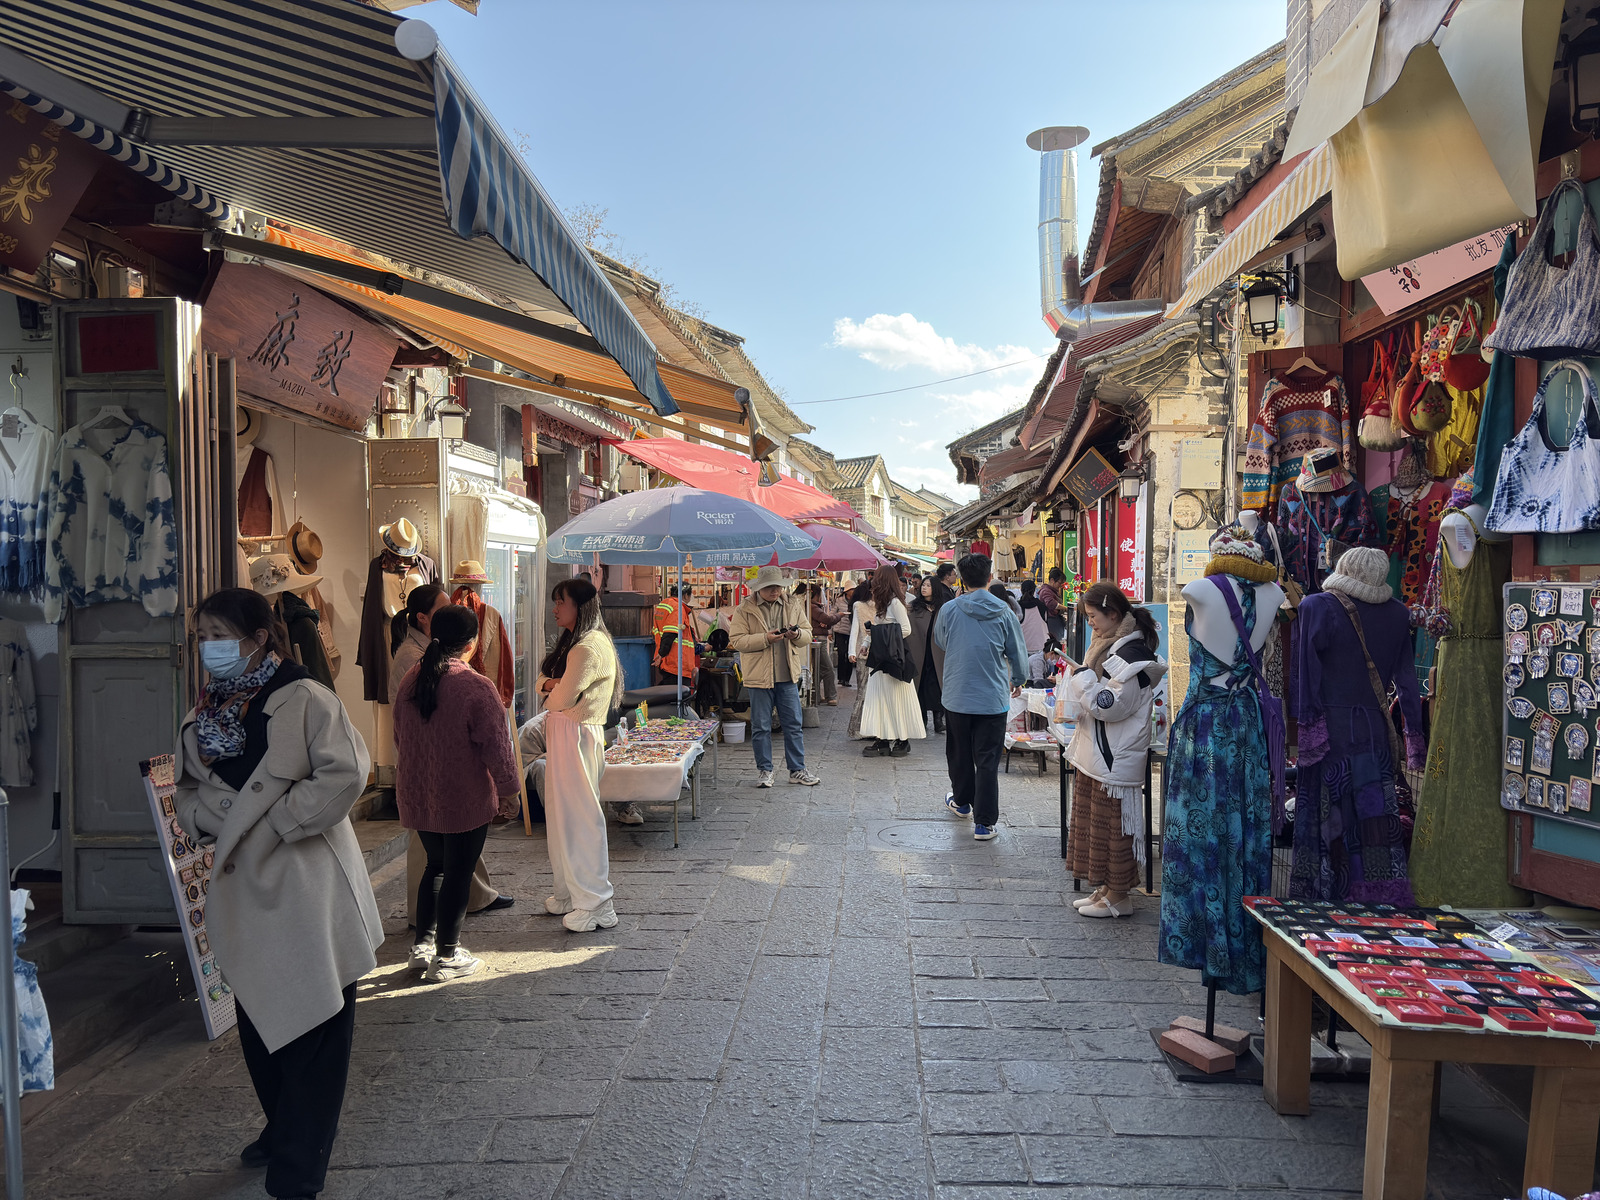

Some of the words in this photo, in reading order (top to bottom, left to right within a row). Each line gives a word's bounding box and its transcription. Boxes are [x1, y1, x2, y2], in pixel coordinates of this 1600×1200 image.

[1464, 238, 1493, 261] 批发
[279, 378, 307, 396] MAZHI
[615, 535, 647, 544] 用雨洁
[1120, 537, 1135, 553] 使
